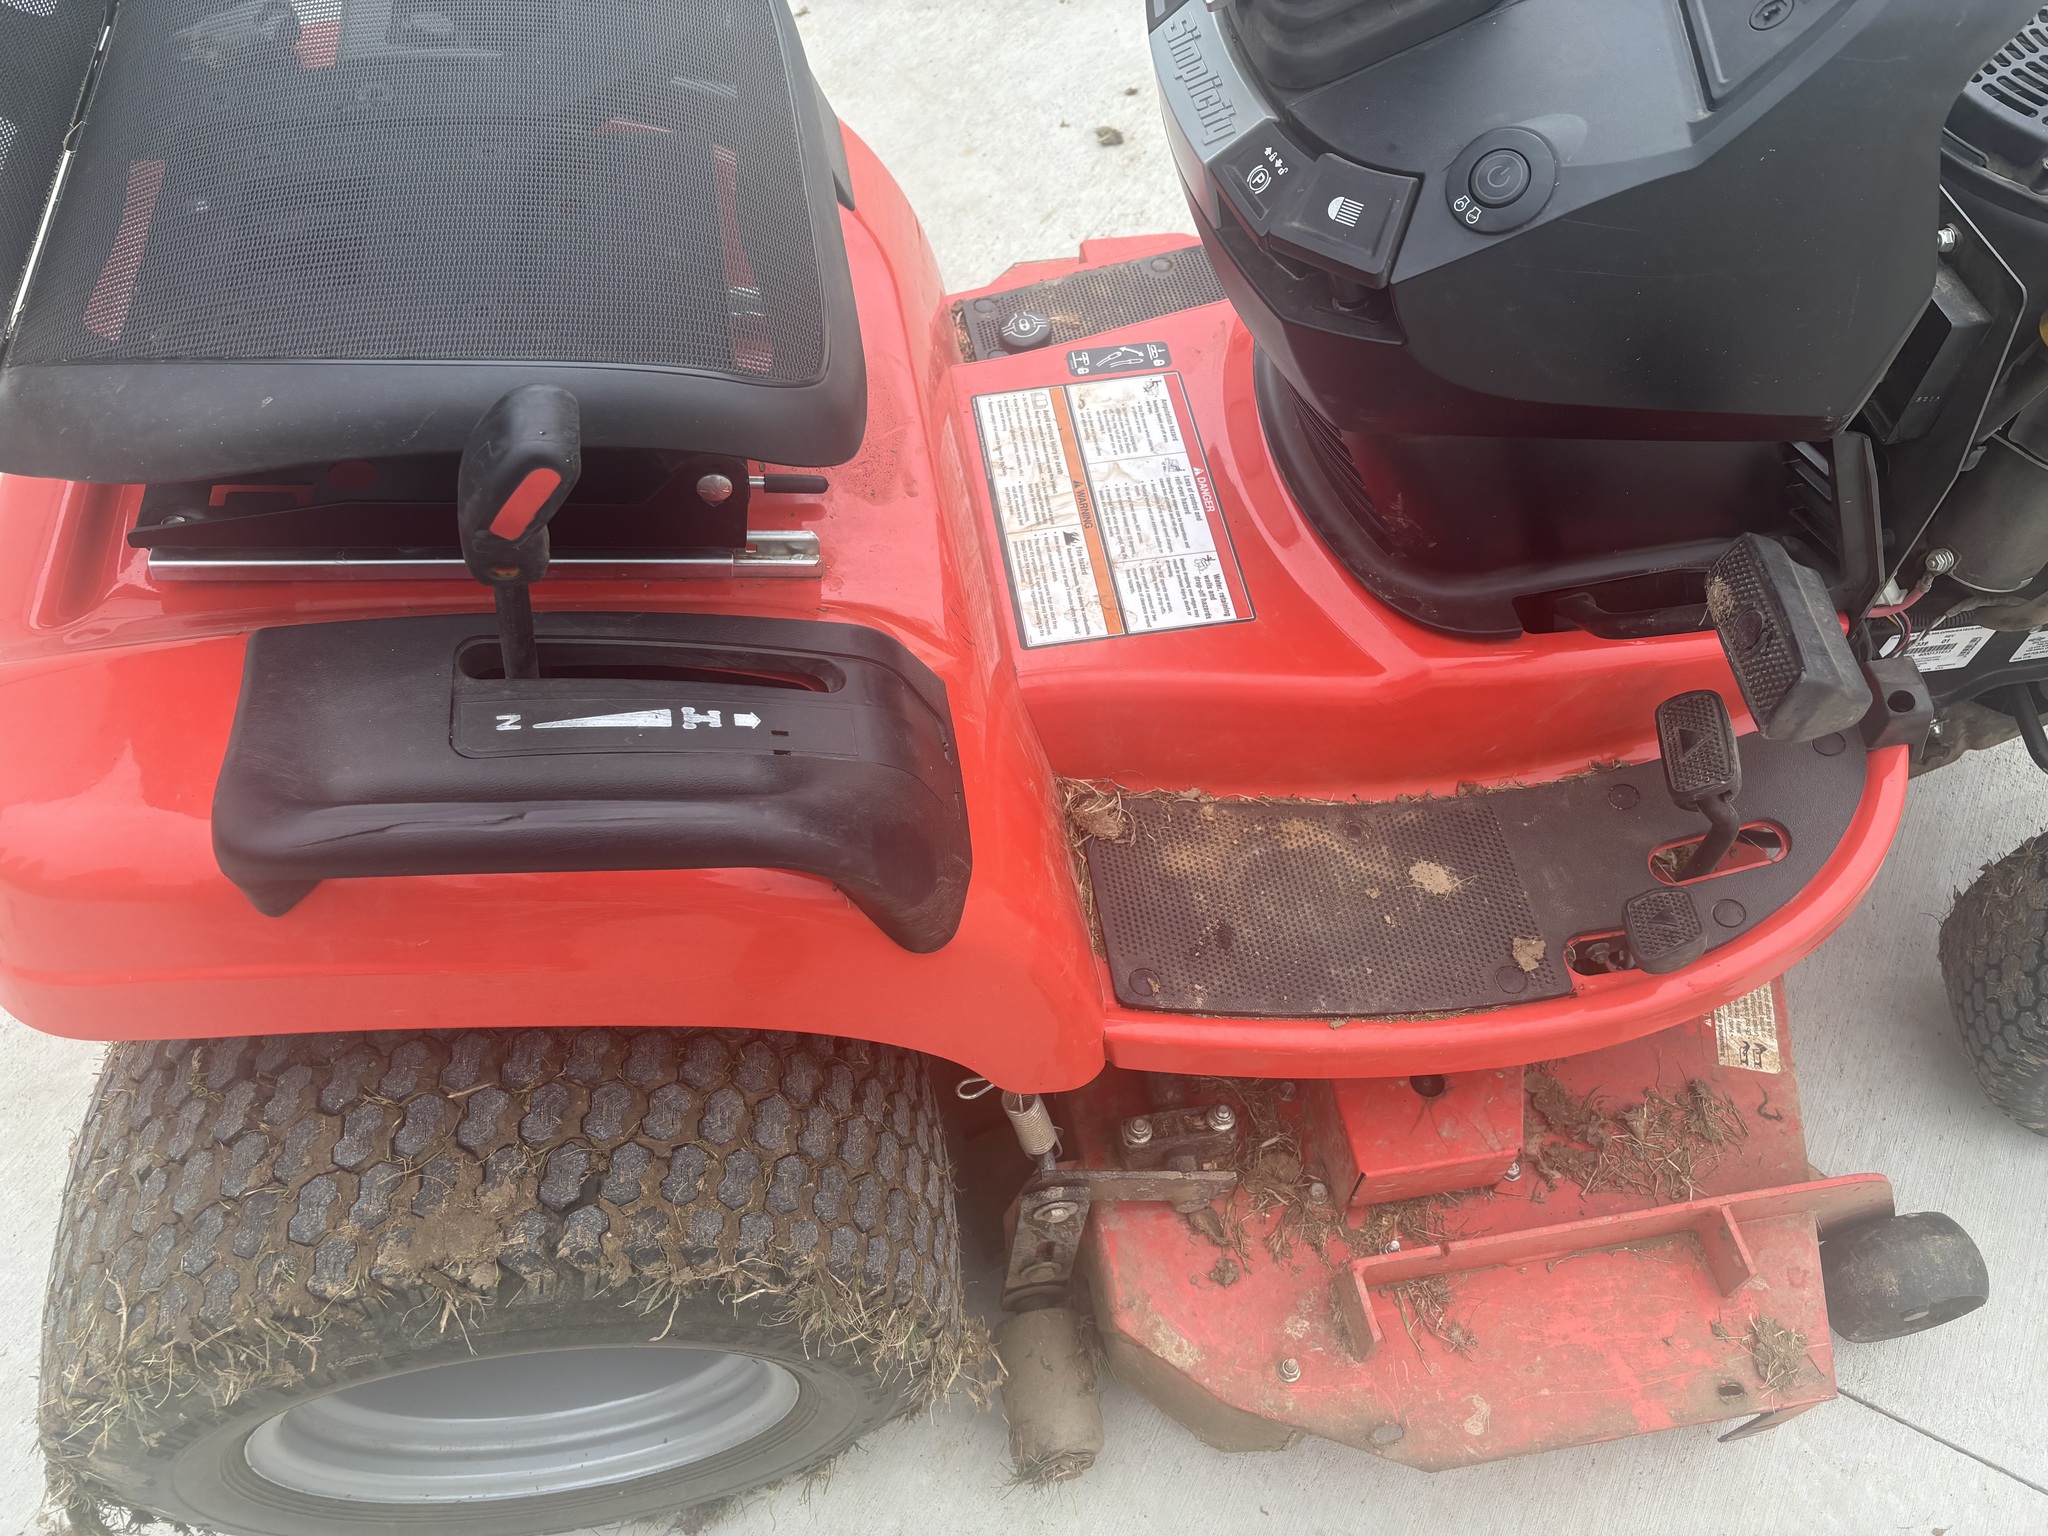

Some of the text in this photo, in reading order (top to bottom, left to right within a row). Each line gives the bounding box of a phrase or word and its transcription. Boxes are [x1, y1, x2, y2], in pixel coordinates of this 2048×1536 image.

[1164, 12, 1236, 146] Simplicity
[1042, 409, 1051, 422] Avoid
[1046, 423, 1055, 439] serious
[1159, 398, 1178, 441] Amputation hazard
[1049, 440, 1058, 454] injury
[1055, 461, 1063, 474] death
[1075, 489, 1093, 529] WARNING
[1174, 476, 1191, 514] roll-over hazard
[1183, 475, 1192, 486] Loss
[1188, 493, 1199, 510] control
[1194, 511, 1202, 521] and
[1196, 476, 1215, 512] DANGER
[1075, 546, 1088, 575] Fire hazard
[1192, 576, 1212, 619] drop-off hazards
[1203, 575, 1216, 600] walls and
[1211, 574, 1231, 616] Water, retaining
[1717, 1024, 1725, 1057] Amputation
